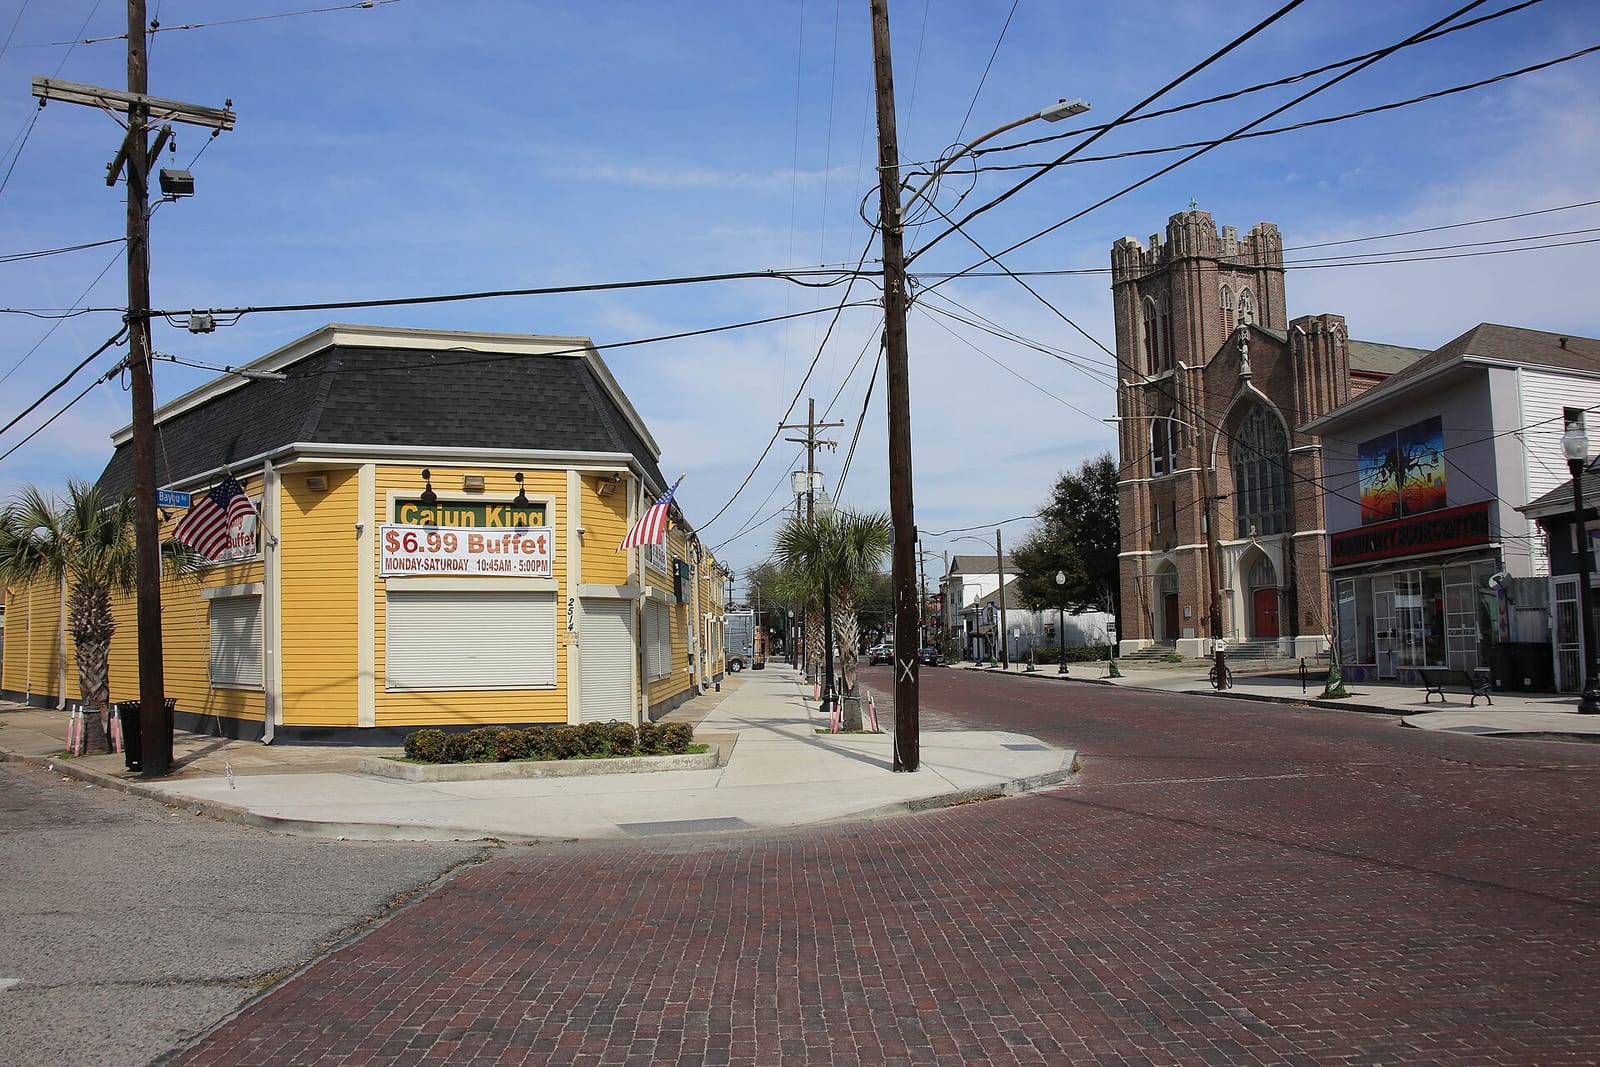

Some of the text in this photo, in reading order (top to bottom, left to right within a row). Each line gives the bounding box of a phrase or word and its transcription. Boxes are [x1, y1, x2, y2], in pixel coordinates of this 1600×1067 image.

[400, 502, 543, 528] Cajun King
[385, 529, 547, 555] $6.99 Buffet
[385, 557, 469, 572] MONDAY-SATURDAY
[477, 558, 512, 572] 10:45AM
[518, 559, 548, 572] 5:00PM
[567, 597, 575, 632] 2514
